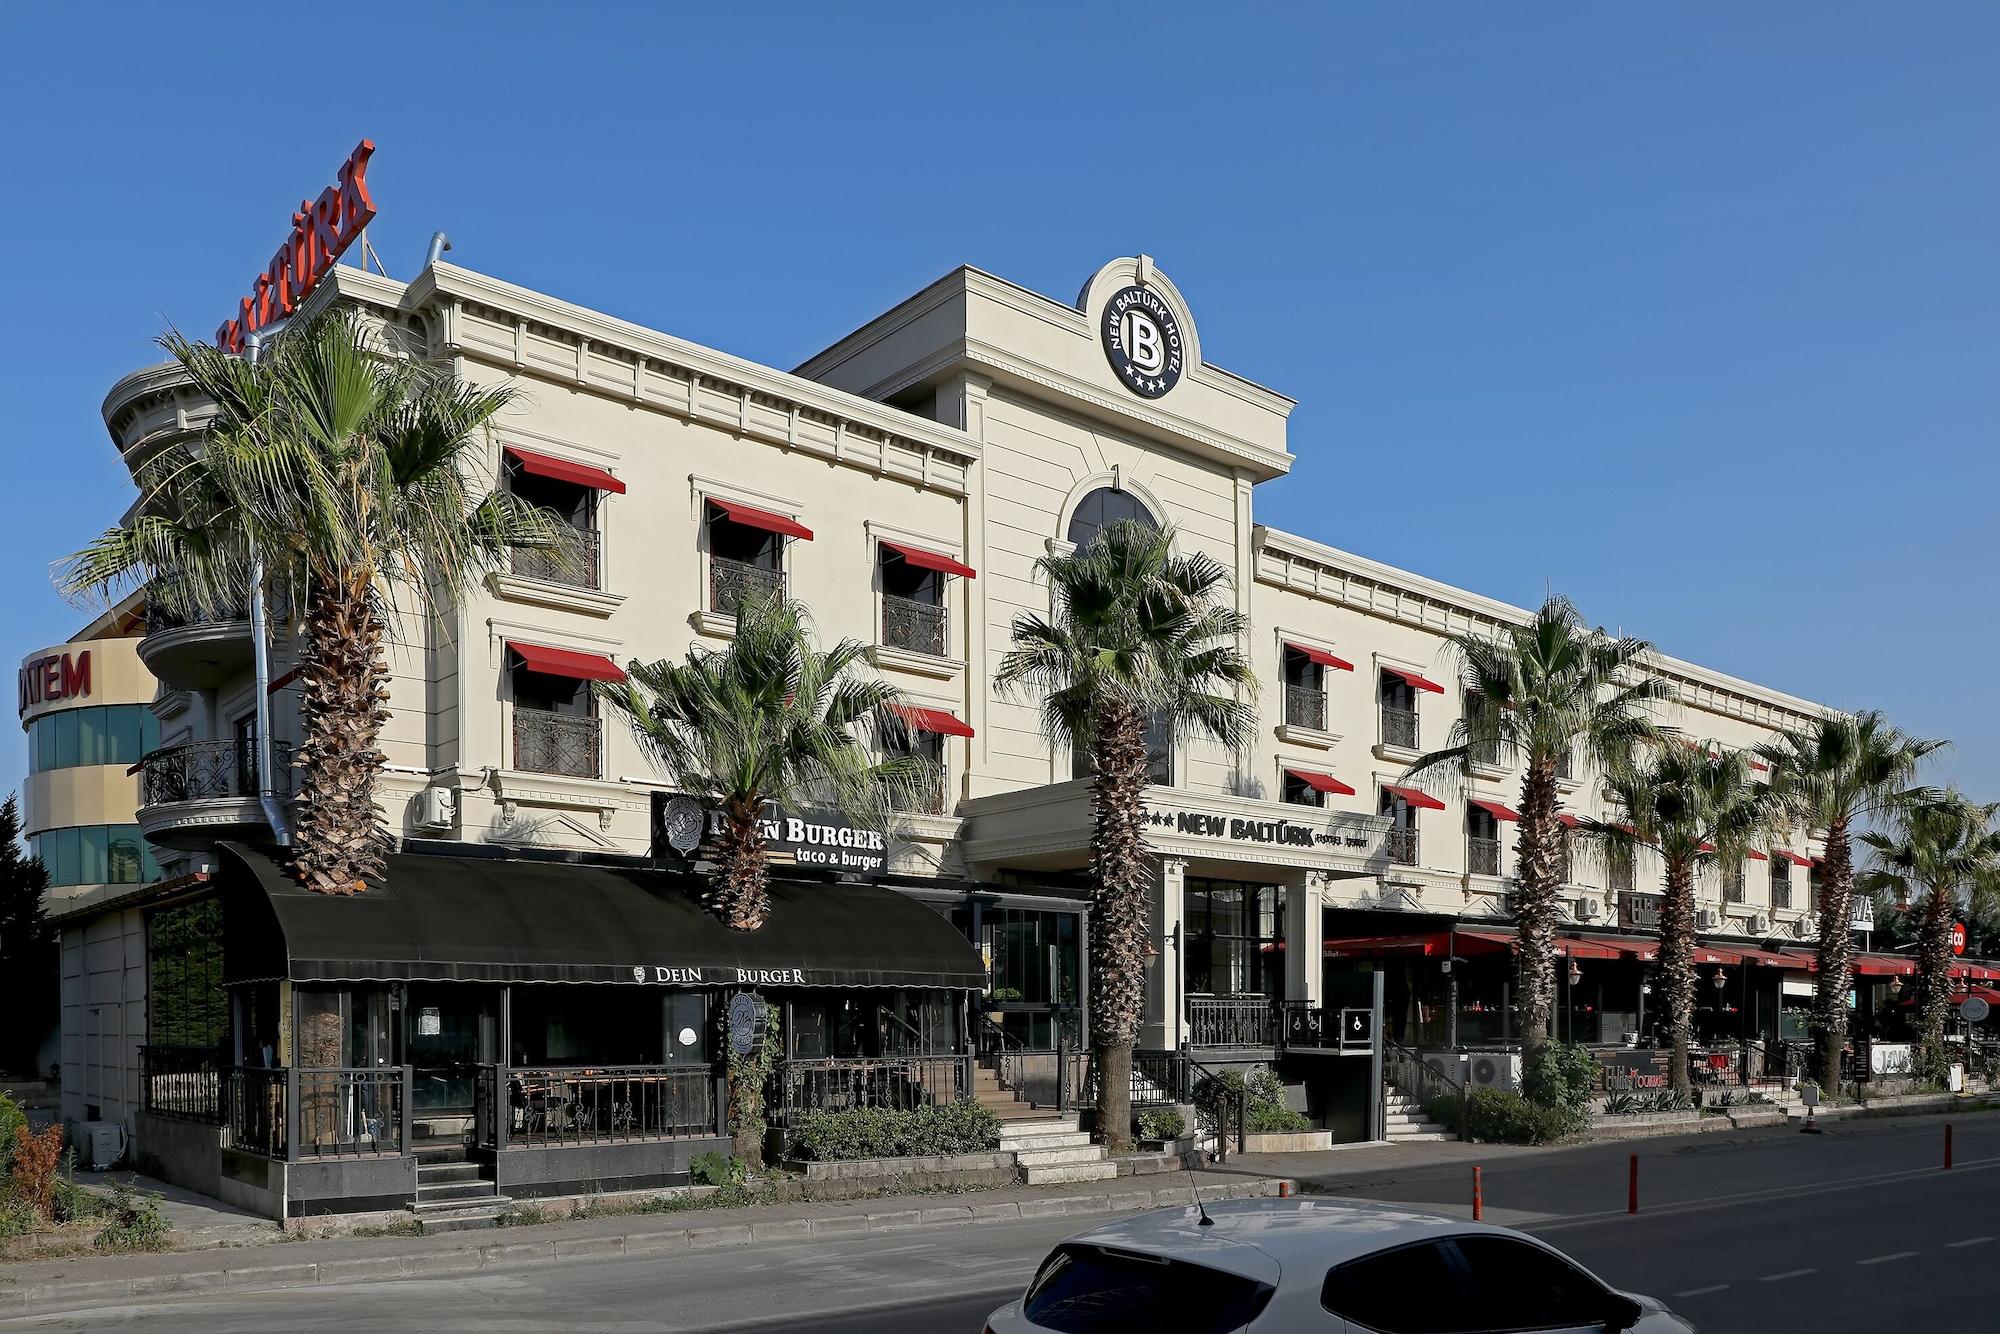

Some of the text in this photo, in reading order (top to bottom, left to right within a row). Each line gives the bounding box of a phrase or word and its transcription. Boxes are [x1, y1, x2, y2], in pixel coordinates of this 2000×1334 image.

[1109, 290, 1181, 374] NEW BALTÜRK HOTEL
[1177, 811, 1227, 837] NEW
[1230, 819, 1315, 847] BALTÜRK
[796, 847, 883, 871] taco & burger
[655, 966, 806, 984] DEIN BURGER
